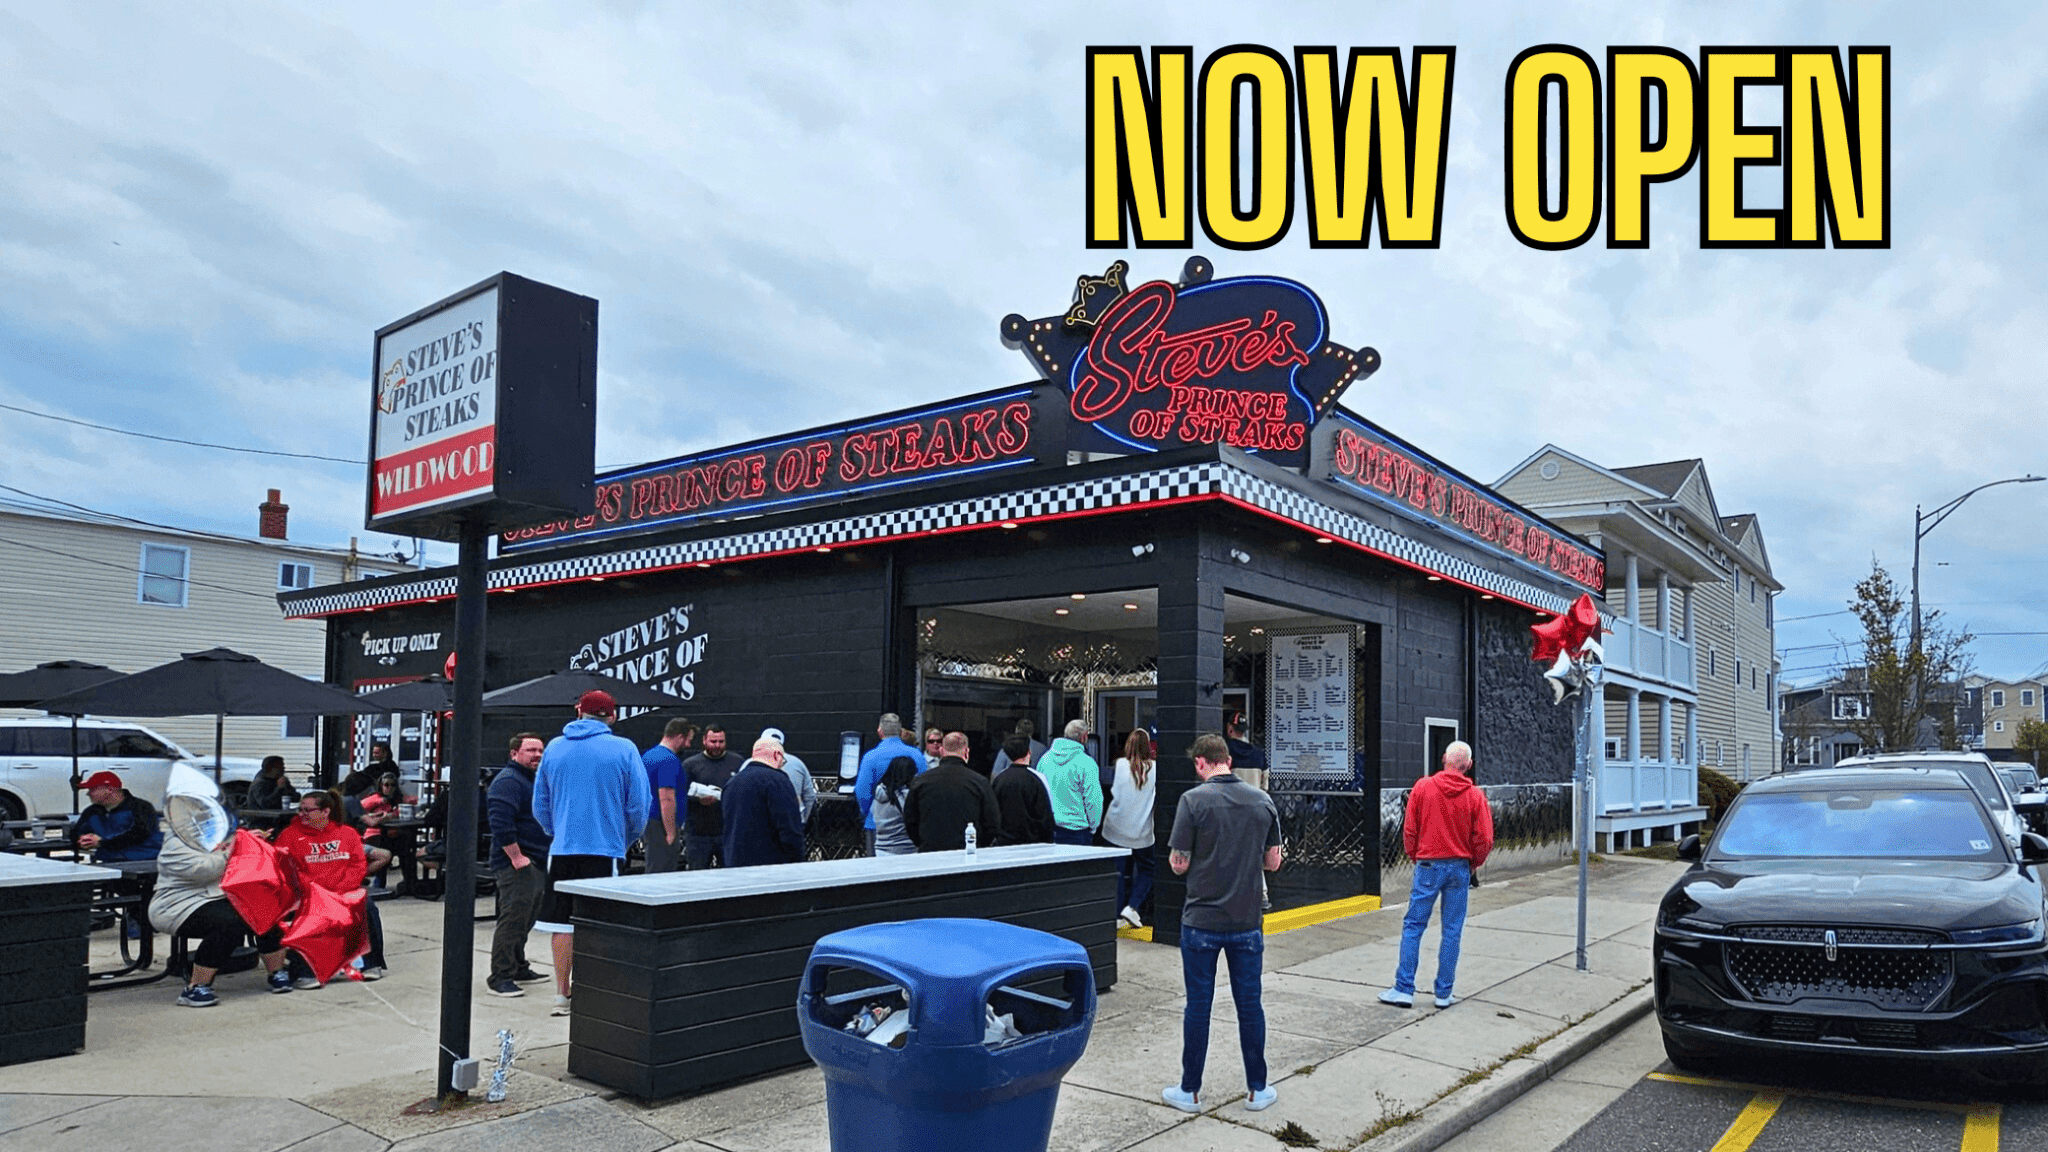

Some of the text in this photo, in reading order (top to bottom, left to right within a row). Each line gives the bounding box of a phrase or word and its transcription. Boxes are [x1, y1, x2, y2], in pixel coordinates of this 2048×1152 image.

[406, 320, 483, 378] STEVE'S
[1071, 280, 1309, 422] Steve's
[391, 350, 497, 415] PRINCE OF
[1166, 386, 1288, 421] PRINCE
[404, 391, 481, 443] STEAKS
[1130, 408, 1306, 451] OF STEAKS
[376, 441, 495, 500] WILDWOOD
[629, 454, 767, 519] PRINCE
[775, 441, 832, 493] OF
[839, 402, 1031, 482] STEAKS
[1335, 427, 1605, 591] STEVE'S PRINCE OF STEAKS
[363, 631, 442, 656] PICK UP ONLY
[597, 605, 690, 664] STEVE'S
[675, 632, 709, 669] OF
